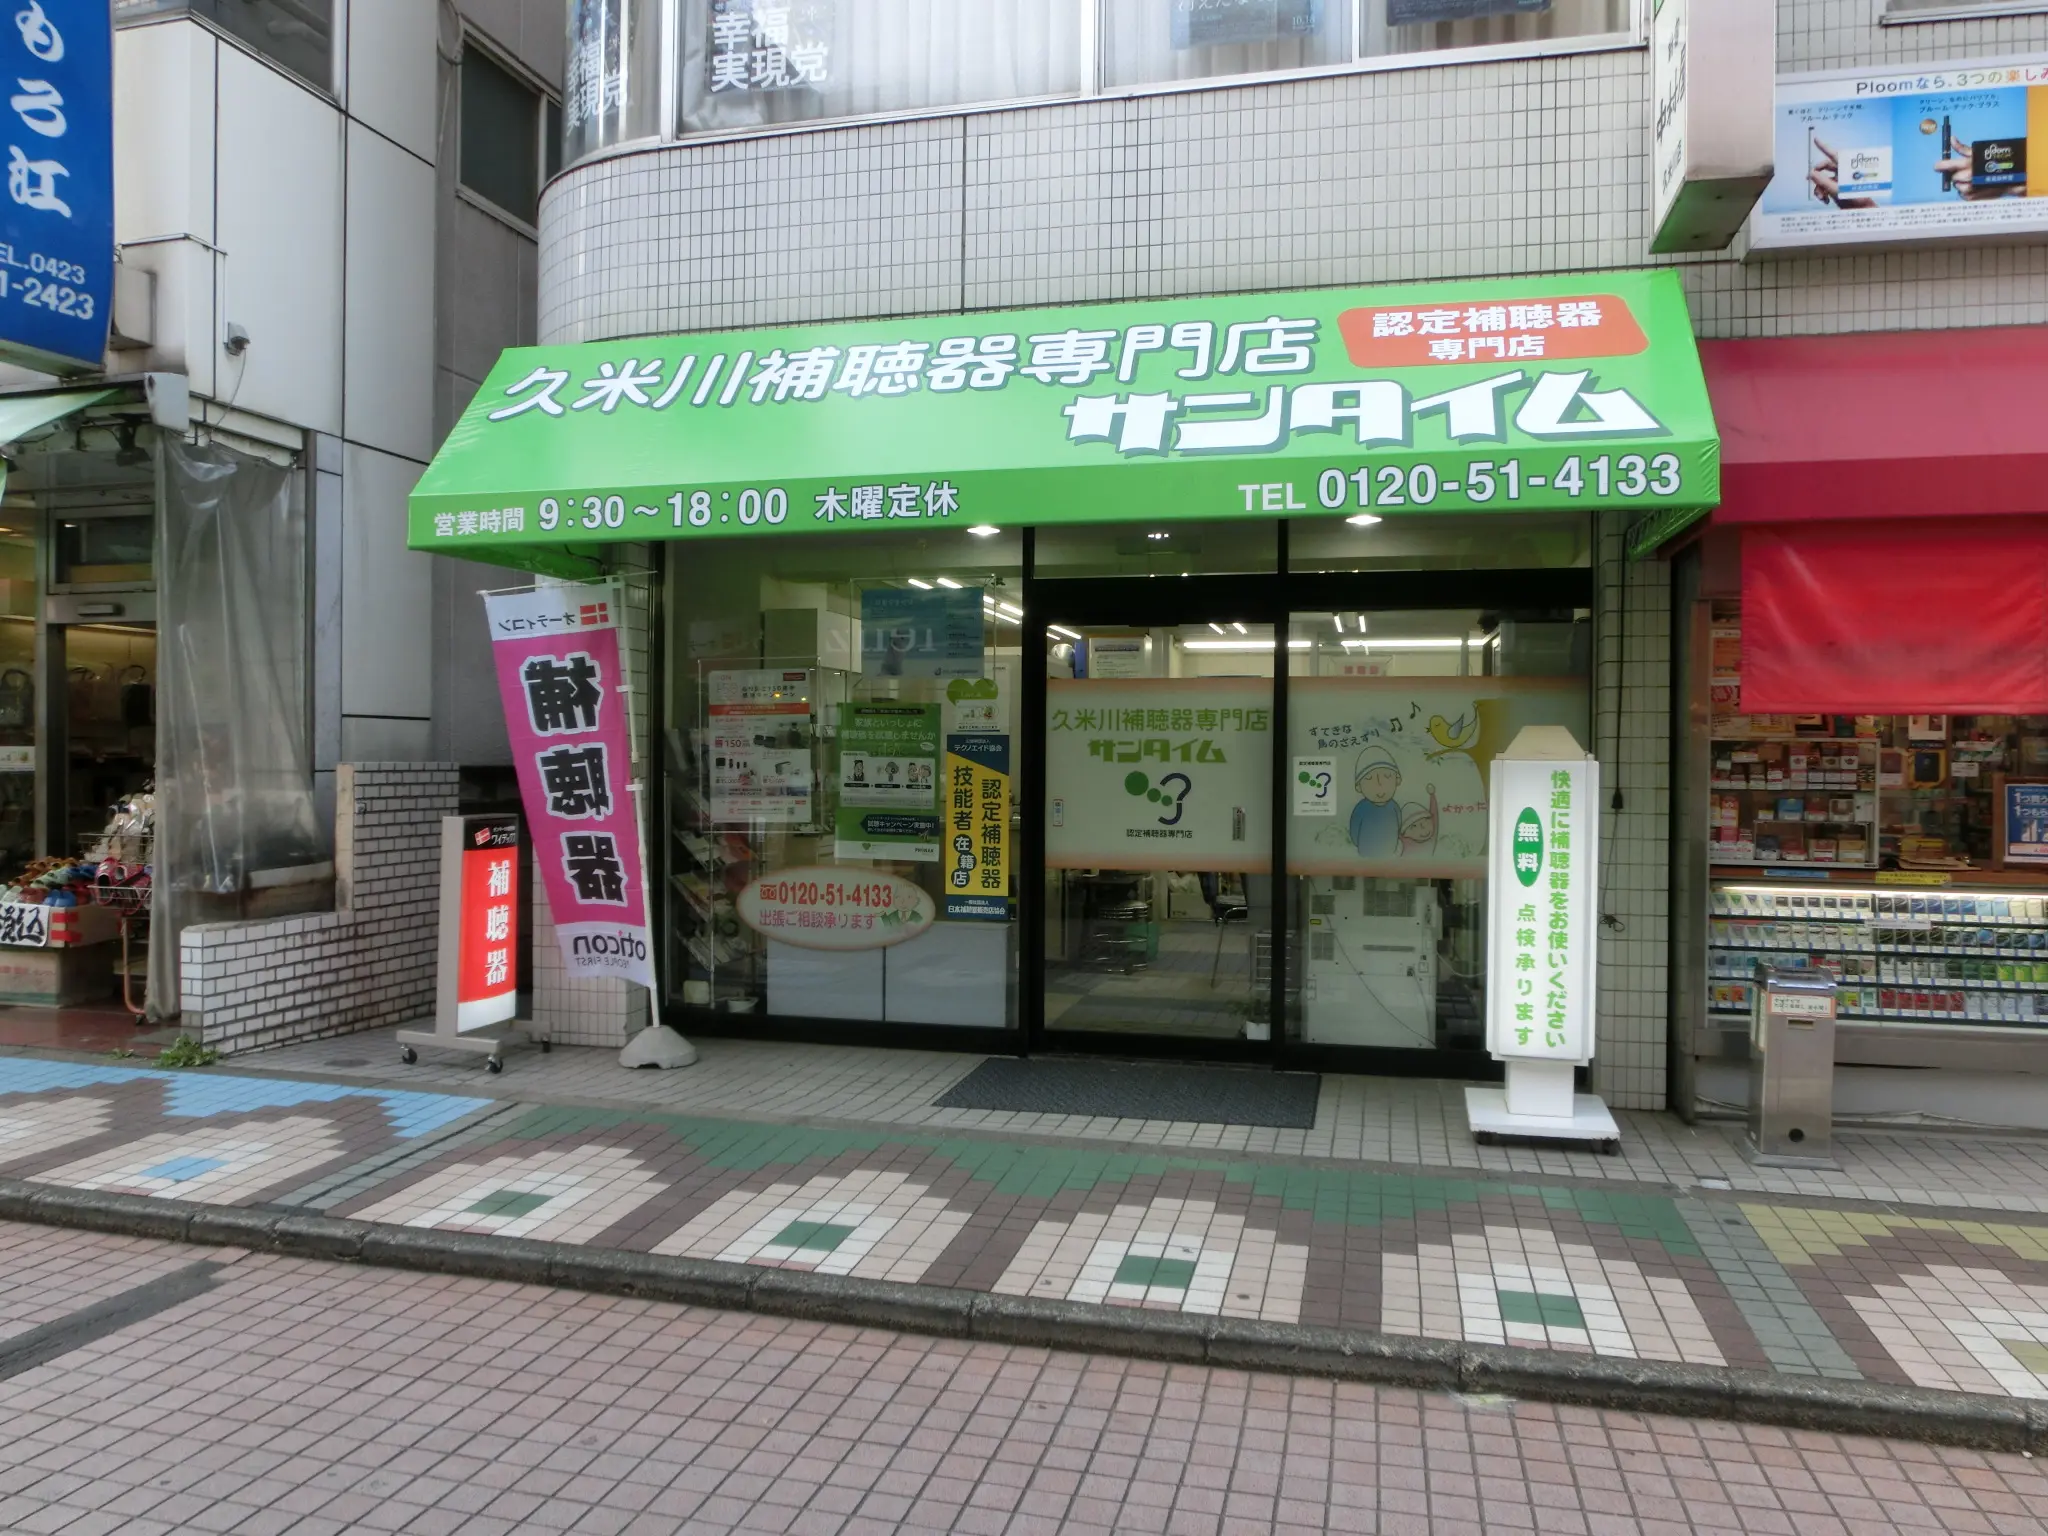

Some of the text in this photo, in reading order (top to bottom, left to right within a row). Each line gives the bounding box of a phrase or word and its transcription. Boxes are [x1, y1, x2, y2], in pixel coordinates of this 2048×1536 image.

[713, 7, 791, 51] 幸福
[711, 42, 829, 93] 実現党
[1372, 300, 1603, 338] 認定補聴器
[487, 314, 1318, 423] 久米川補聴器専門店
[1428, 335, 1546, 361] 専門店
[1062, 368, 1666, 456] サンタイム
[433, 504, 526, 538] 営業時間
[814, 480, 960, 523] 木曜定休
[1237, 452, 1684, 512] TEL 0120-51-4133
[1051, 708, 1269, 732] 久米川補聴器専門店
[1309, 724, 1352, 736] すてきな
[1087, 738, 1228, 763] サンタイム
[981, 779, 1002, 889] 認定補聴器
[1517, 822, 1539, 872] 無料
[485, 860, 511, 986] 補聴器
[1545, 769, 1572, 1048] 快適に補聴器をお使いください
[1514, 903, 1537, 1046] 点検承ります
